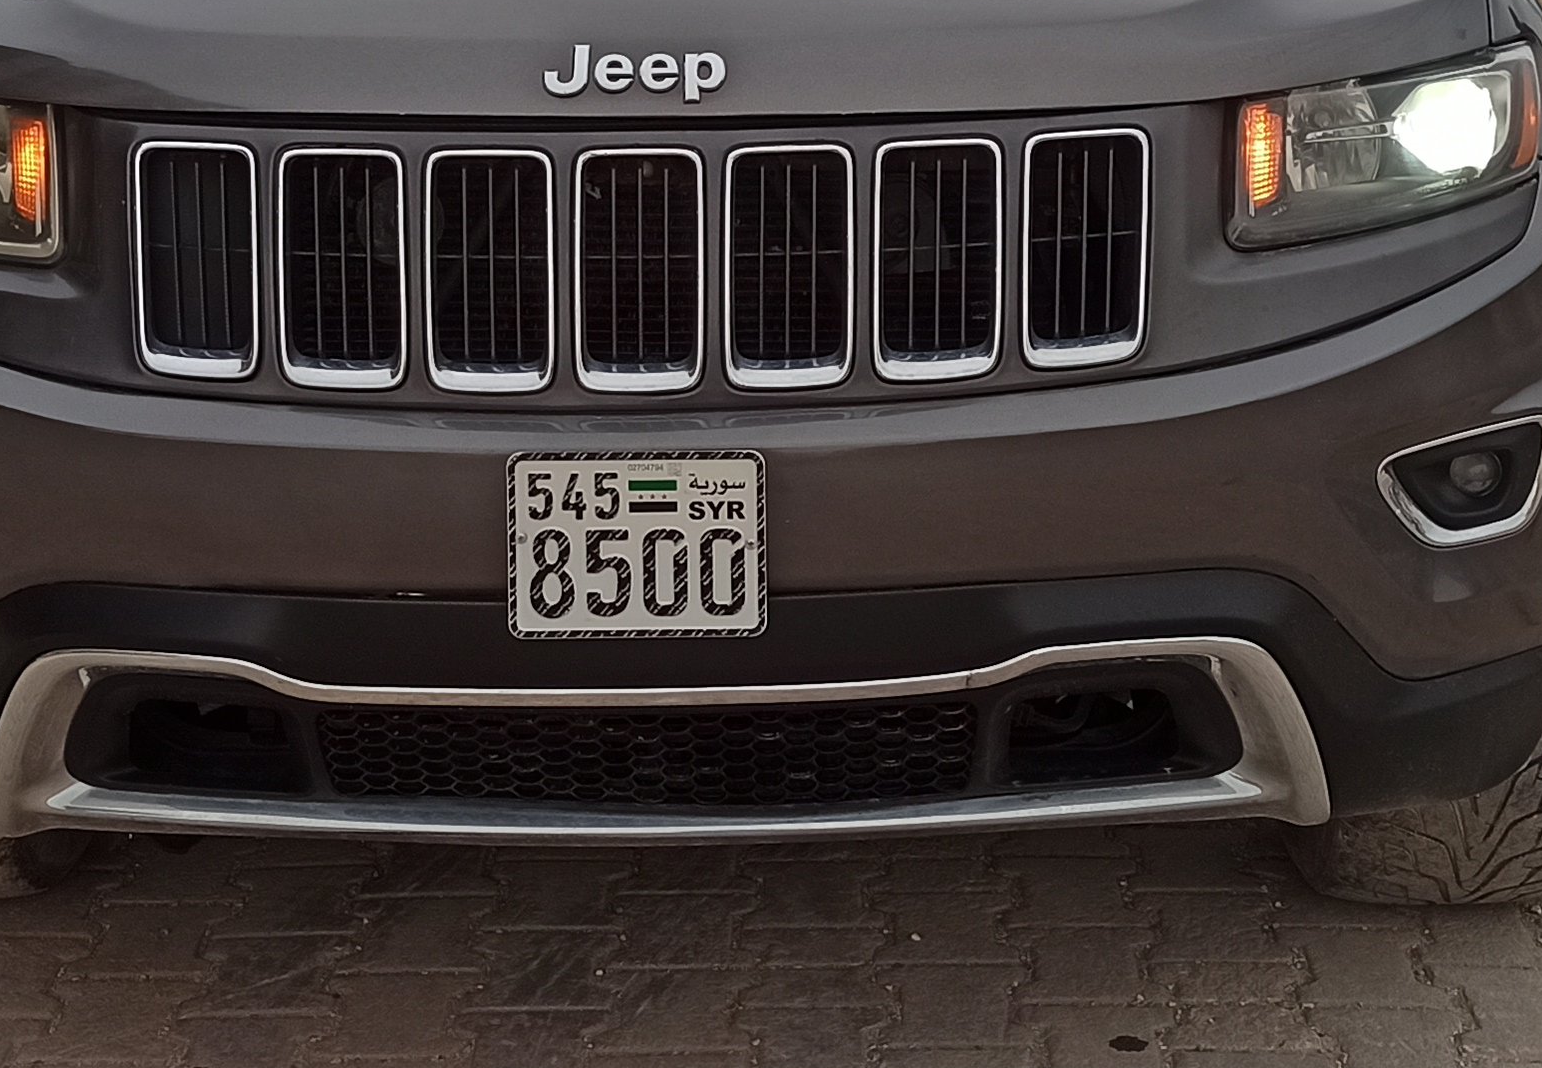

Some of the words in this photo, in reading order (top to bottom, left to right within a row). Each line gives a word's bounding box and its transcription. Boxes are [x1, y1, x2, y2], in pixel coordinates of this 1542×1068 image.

[543, 44, 727, 103] Jeep
[527, 473, 621, 520] 545
[688, 473, 746, 495] سورية
[688, 501, 746, 520] SYR
[529, 528, 746, 618] 8500
